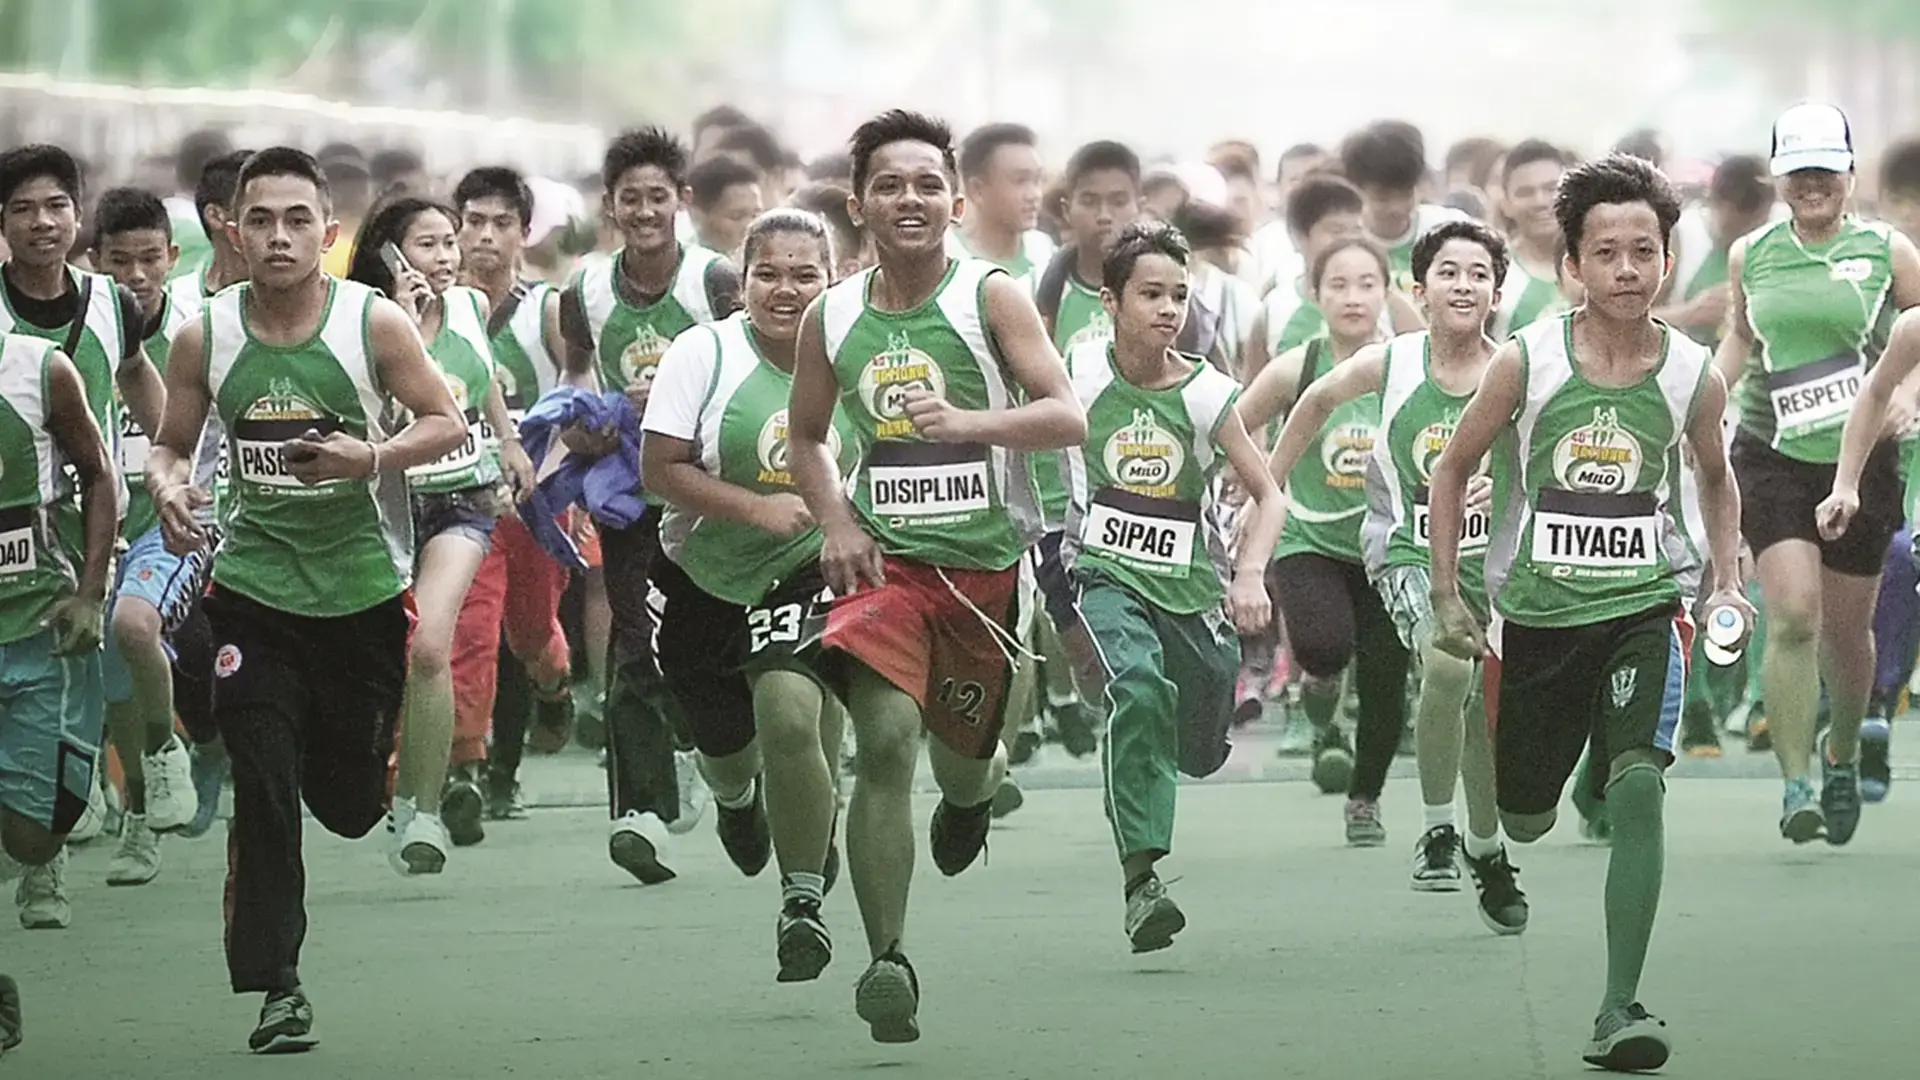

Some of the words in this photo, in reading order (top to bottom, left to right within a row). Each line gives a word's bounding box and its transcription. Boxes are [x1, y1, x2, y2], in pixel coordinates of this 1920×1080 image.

[1778, 376, 1860, 417] RESPETO
[875, 473, 986, 505] DISIPLINA
[1129, 465, 1162, 477] MILO
[1578, 471, 1617, 486] MILO
[1101, 517, 1176, 558] SIPAG
[1546, 523, 1646, 559] TIYAGA
[747, 603, 802, 654] 23
